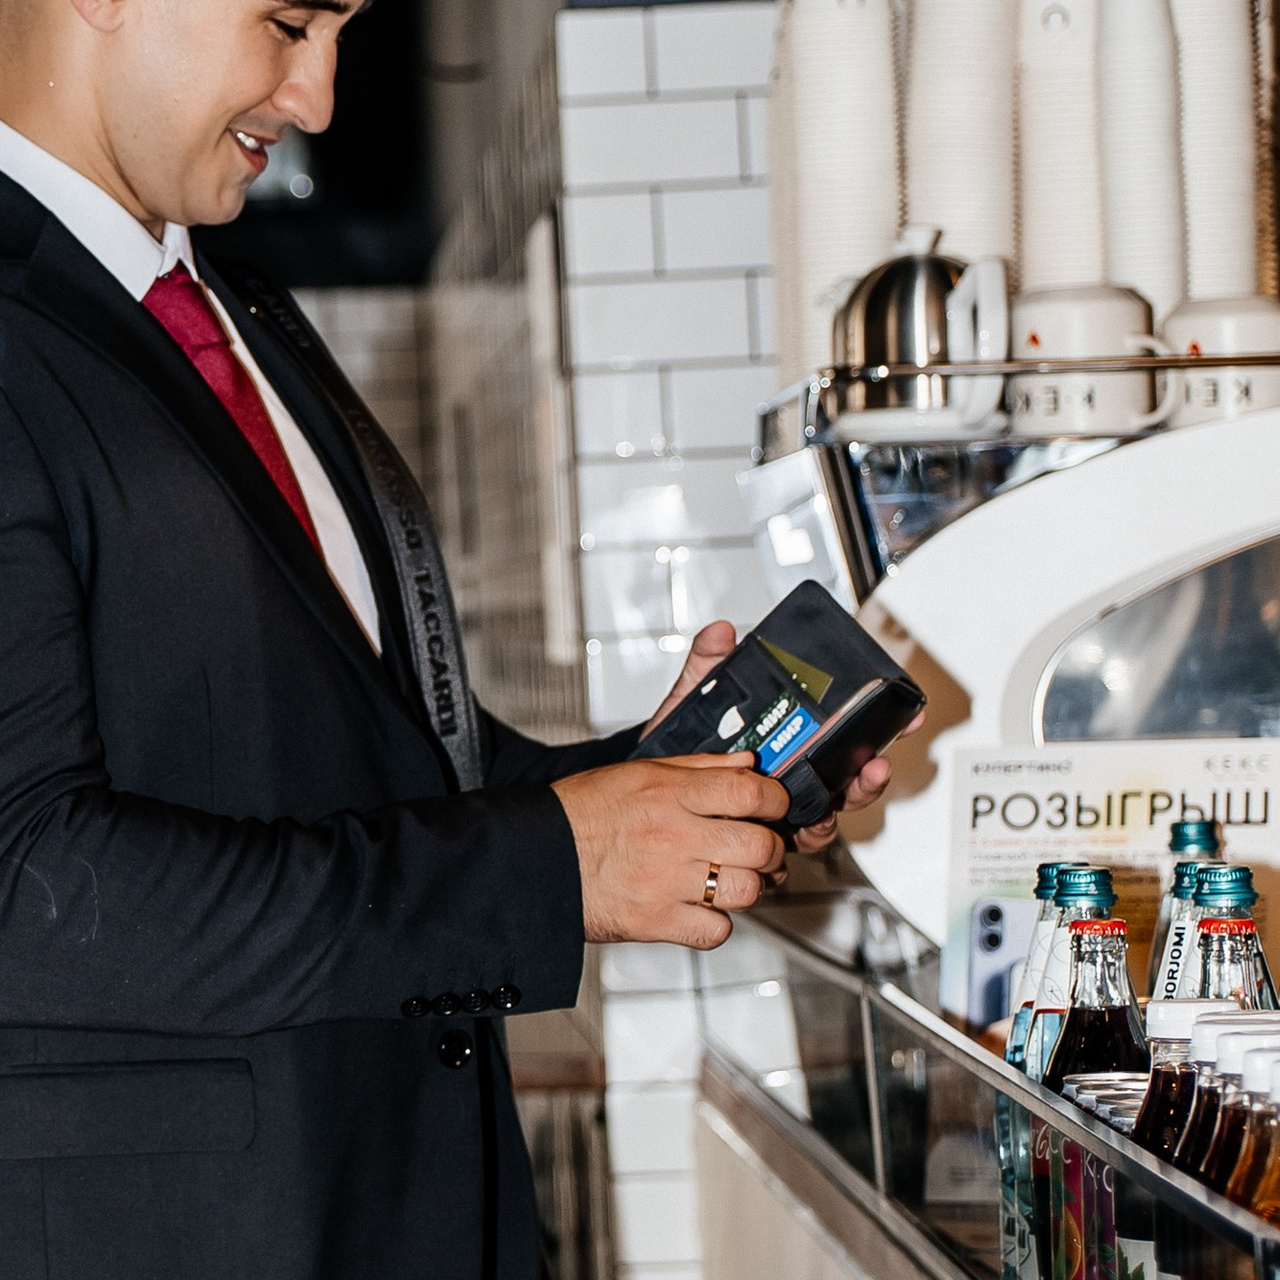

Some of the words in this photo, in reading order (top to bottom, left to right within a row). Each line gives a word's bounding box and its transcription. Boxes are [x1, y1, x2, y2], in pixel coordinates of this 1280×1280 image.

[413, 567, 459, 738] TACCARDI
[756, 699, 790, 737] МИР
[770, 715, 804, 753] МИР
[970, 791, 1270, 831] РОЗЫГРЫШ
